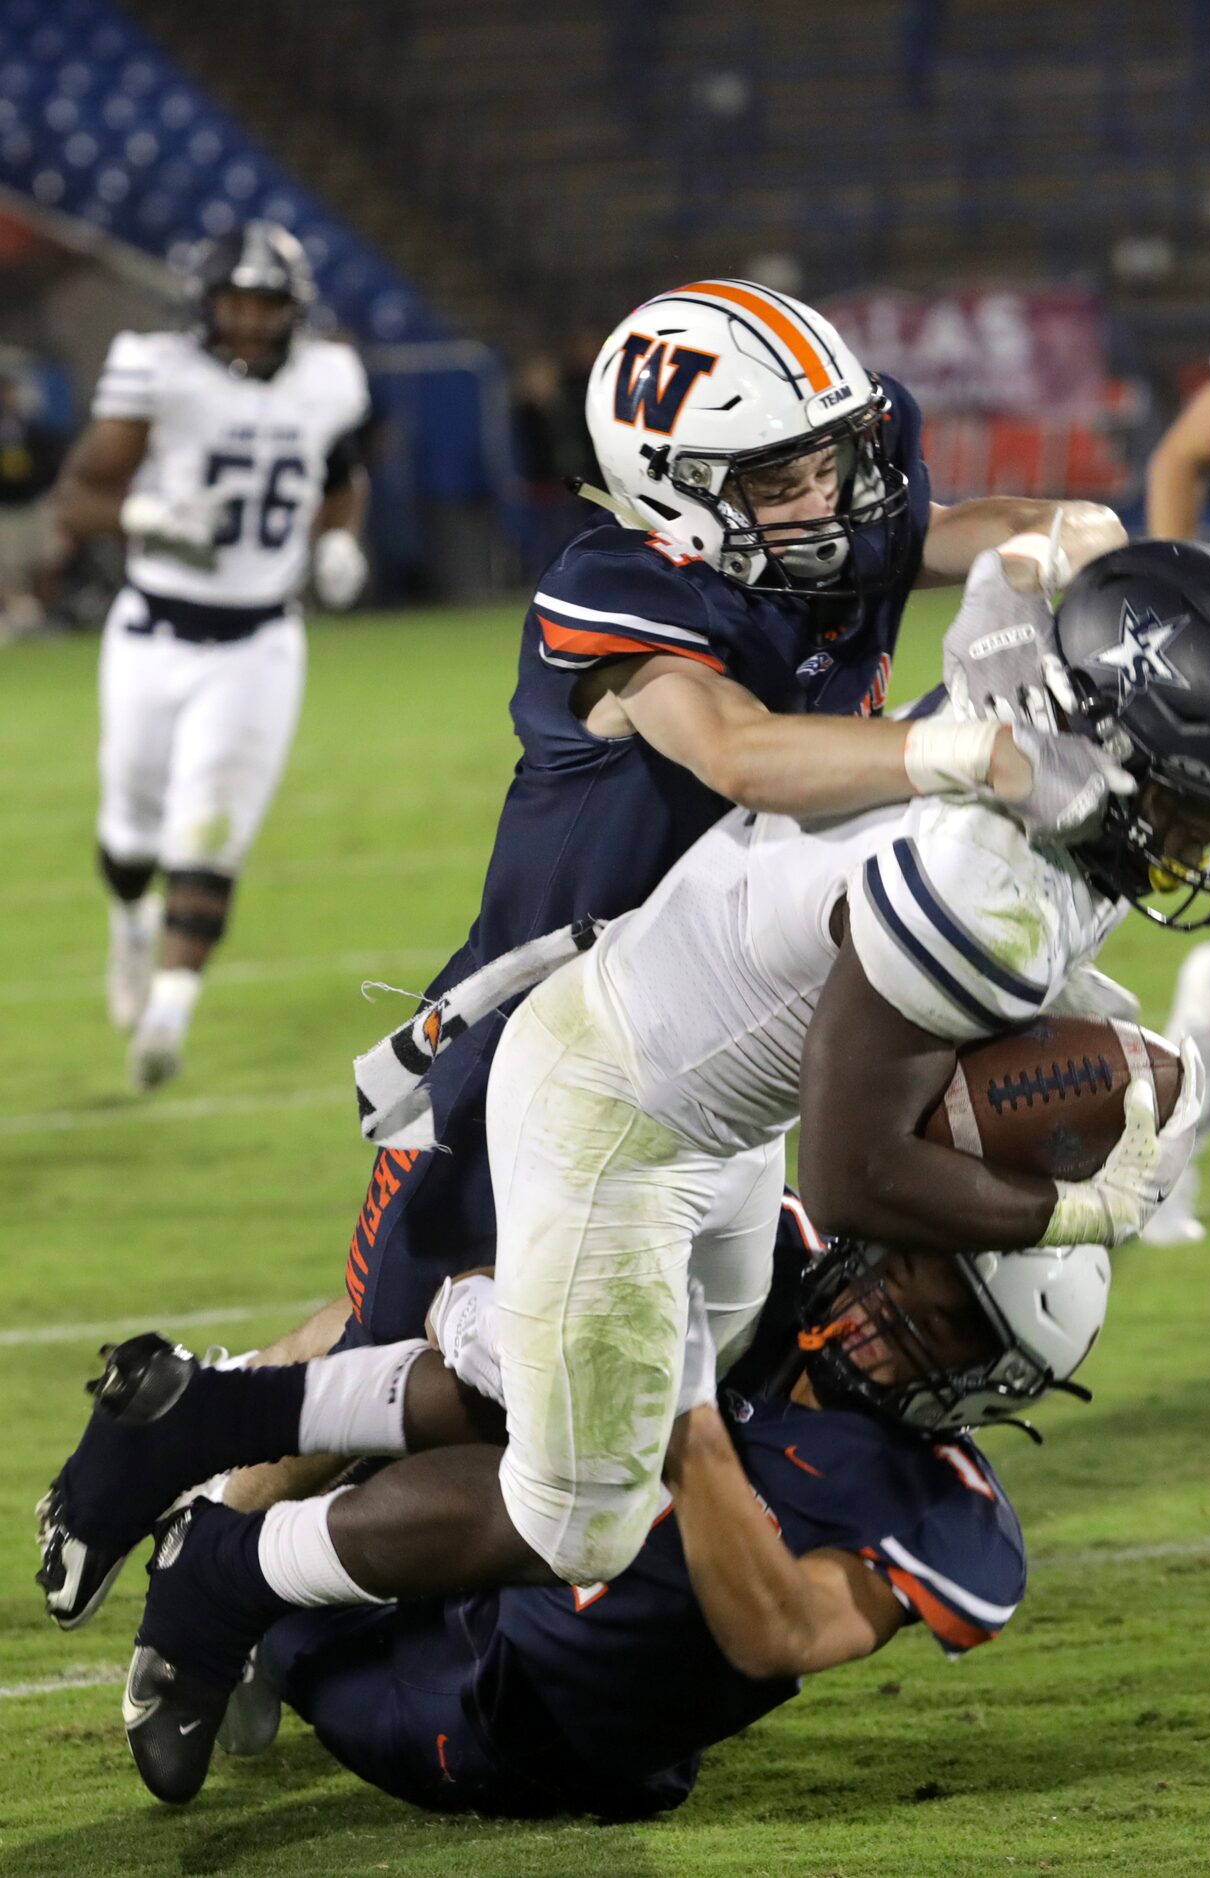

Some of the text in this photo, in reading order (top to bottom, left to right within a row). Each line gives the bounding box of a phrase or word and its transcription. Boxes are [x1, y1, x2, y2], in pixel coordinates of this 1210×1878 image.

[612, 331, 721, 438] W
[818, 384, 853, 410] TEAM
[204, 453, 305, 549] 56
